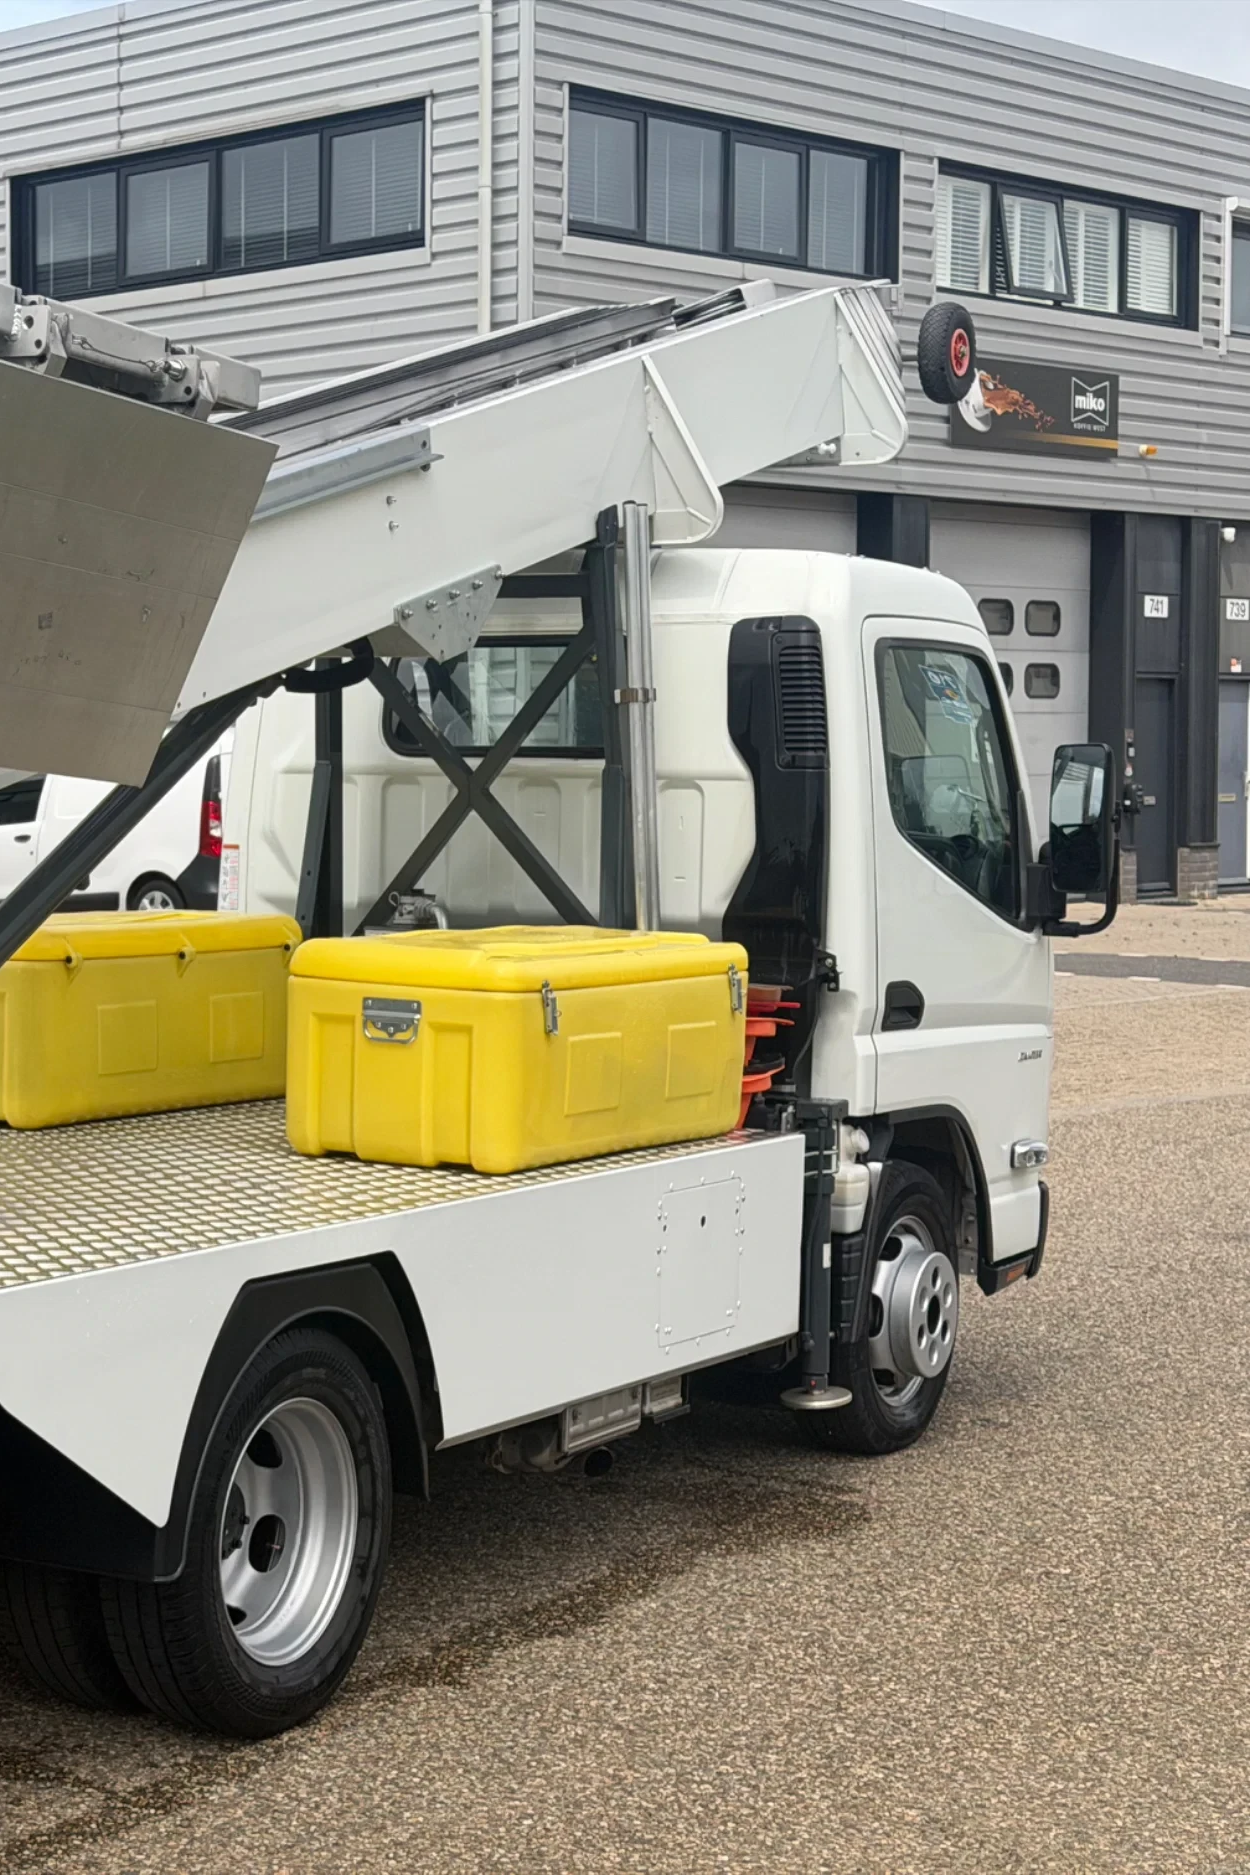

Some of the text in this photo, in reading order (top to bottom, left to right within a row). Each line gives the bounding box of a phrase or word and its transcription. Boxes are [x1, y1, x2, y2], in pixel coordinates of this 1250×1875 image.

[1074, 392, 1106, 412] miko
[1149, 598, 1165, 615] 741
[1229, 601, 1247, 618] 739
